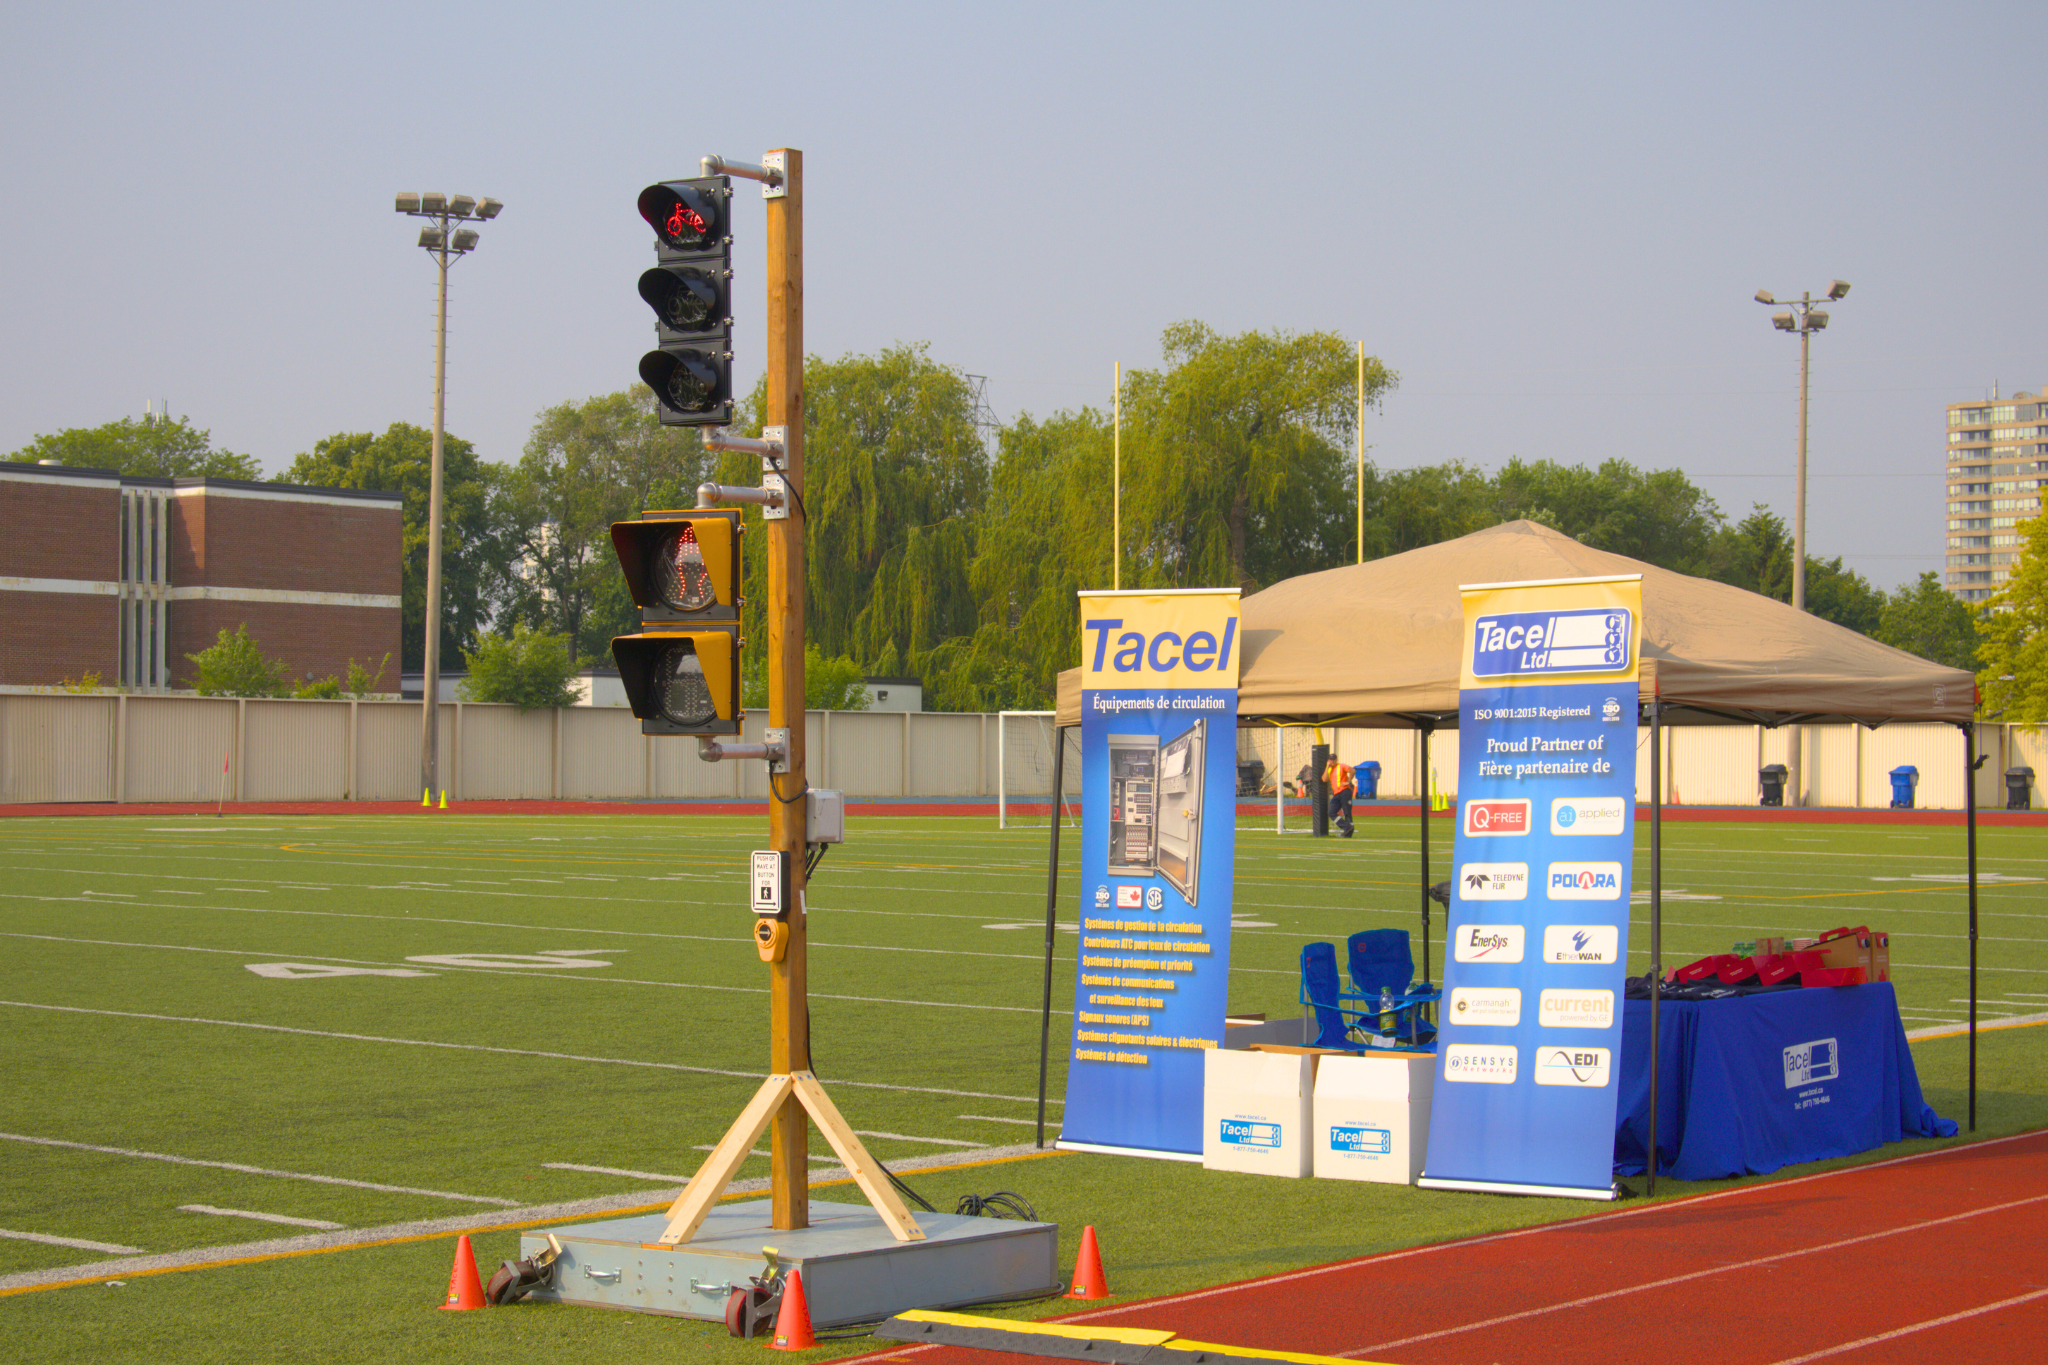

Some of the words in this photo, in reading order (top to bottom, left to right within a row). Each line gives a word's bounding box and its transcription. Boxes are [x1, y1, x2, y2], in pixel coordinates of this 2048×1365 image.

[1478, 617, 1555, 652] Tacel
[1085, 617, 1238, 673] Tacel
[1094, 693, 1154, 713] Équipements
[1157, 695, 1169, 709] de
[1172, 696, 1225, 709] circulation
[1602, 704, 1620, 712] ISO
[1474, 708, 1492, 720] ISO
[1494, 707, 1537, 719] 9001:2015
[1538, 705, 1590, 720] Registered
[1487, 737, 1528, 753] Proud
[1531, 737, 1585, 751] Partner
[1588, 735, 1604, 750] of
[1479, 760, 1512, 776] Fière
[1516, 759, 1588, 779] partenaire
[1592, 758, 1610, 773] de
[1474, 807, 1522, 828] Q-FREE
[1579, 808, 1620, 819] applied
[1096, 892, 1110, 900] ISO
[1085, 918, 1114, 930] Systèmes
[1116, 919, 1123, 930] de
[1124, 920, 1147, 931] gestion
[1148, 920, 1156, 931] de
[1158, 921, 1164, 932] la
[1166, 922, 1202, 934] circulation
[1084, 936, 1120, 949] Contrôleurs
[1121, 938, 1133, 949] ATC
[1134, 940, 1148, 951] pour
[1148, 939, 1163, 951] feux
[1164, 940, 1172, 951] de
[1173, 940, 1210, 953] circulation
[1470, 929, 1508, 950] EnerSys
[1083, 955, 1112, 967] Systèmes
[1114, 957, 1121, 967] de
[1122, 957, 1159, 970] préemption
[1160, 960, 1167, 970] et
[1167, 960, 1193, 971] priorité
[1556, 953, 1602, 961] EtherWAN
[1082, 974, 1111, 986] Systèmes
[1112, 976, 1120, 986] de
[1122, 977, 1174, 990] communications
[1090, 994, 1096, 1004] et
[1097, 995, 1135, 1007] surveillance
[1136, 996, 1149, 1007] des
[1150, 997, 1163, 1008] feux
[1472, 999, 1510, 1007] carmanah
[1544, 996, 1609, 1013] current
[1079, 1011, 1104, 1024] Signaux
[1105, 1014, 1130, 1025] sonores
[1131, 1015, 1149, 1026] (APS)
[1560, 1014, 1589, 1022] powered
[1590, 1015, 1598, 1023] by
[1599, 1014, 1608, 1022] GE
[1077, 1030, 1107, 1042] Systèmes
[1109, 1032, 1145, 1045] clignotants
[1146, 1035, 1172, 1047] solaires
[1173, 1037, 1178, 1047] &
[1179, 1036, 1218, 1049] électriques
[1076, 1048, 1106, 1061] Systèmes
[1107, 1050, 1115, 1061] de
[1116, 1051, 1147, 1064] détection
[1464, 1056, 1513, 1066] SENSYS
[1574, 1054, 1598, 1066] EDI
[1785, 1046, 1810, 1072] Tacel
[1463, 1066, 1513, 1074] Networks
[1222, 1122, 1252, 1136] Tacel
[1331, 1129, 1362, 1142] Tacel
